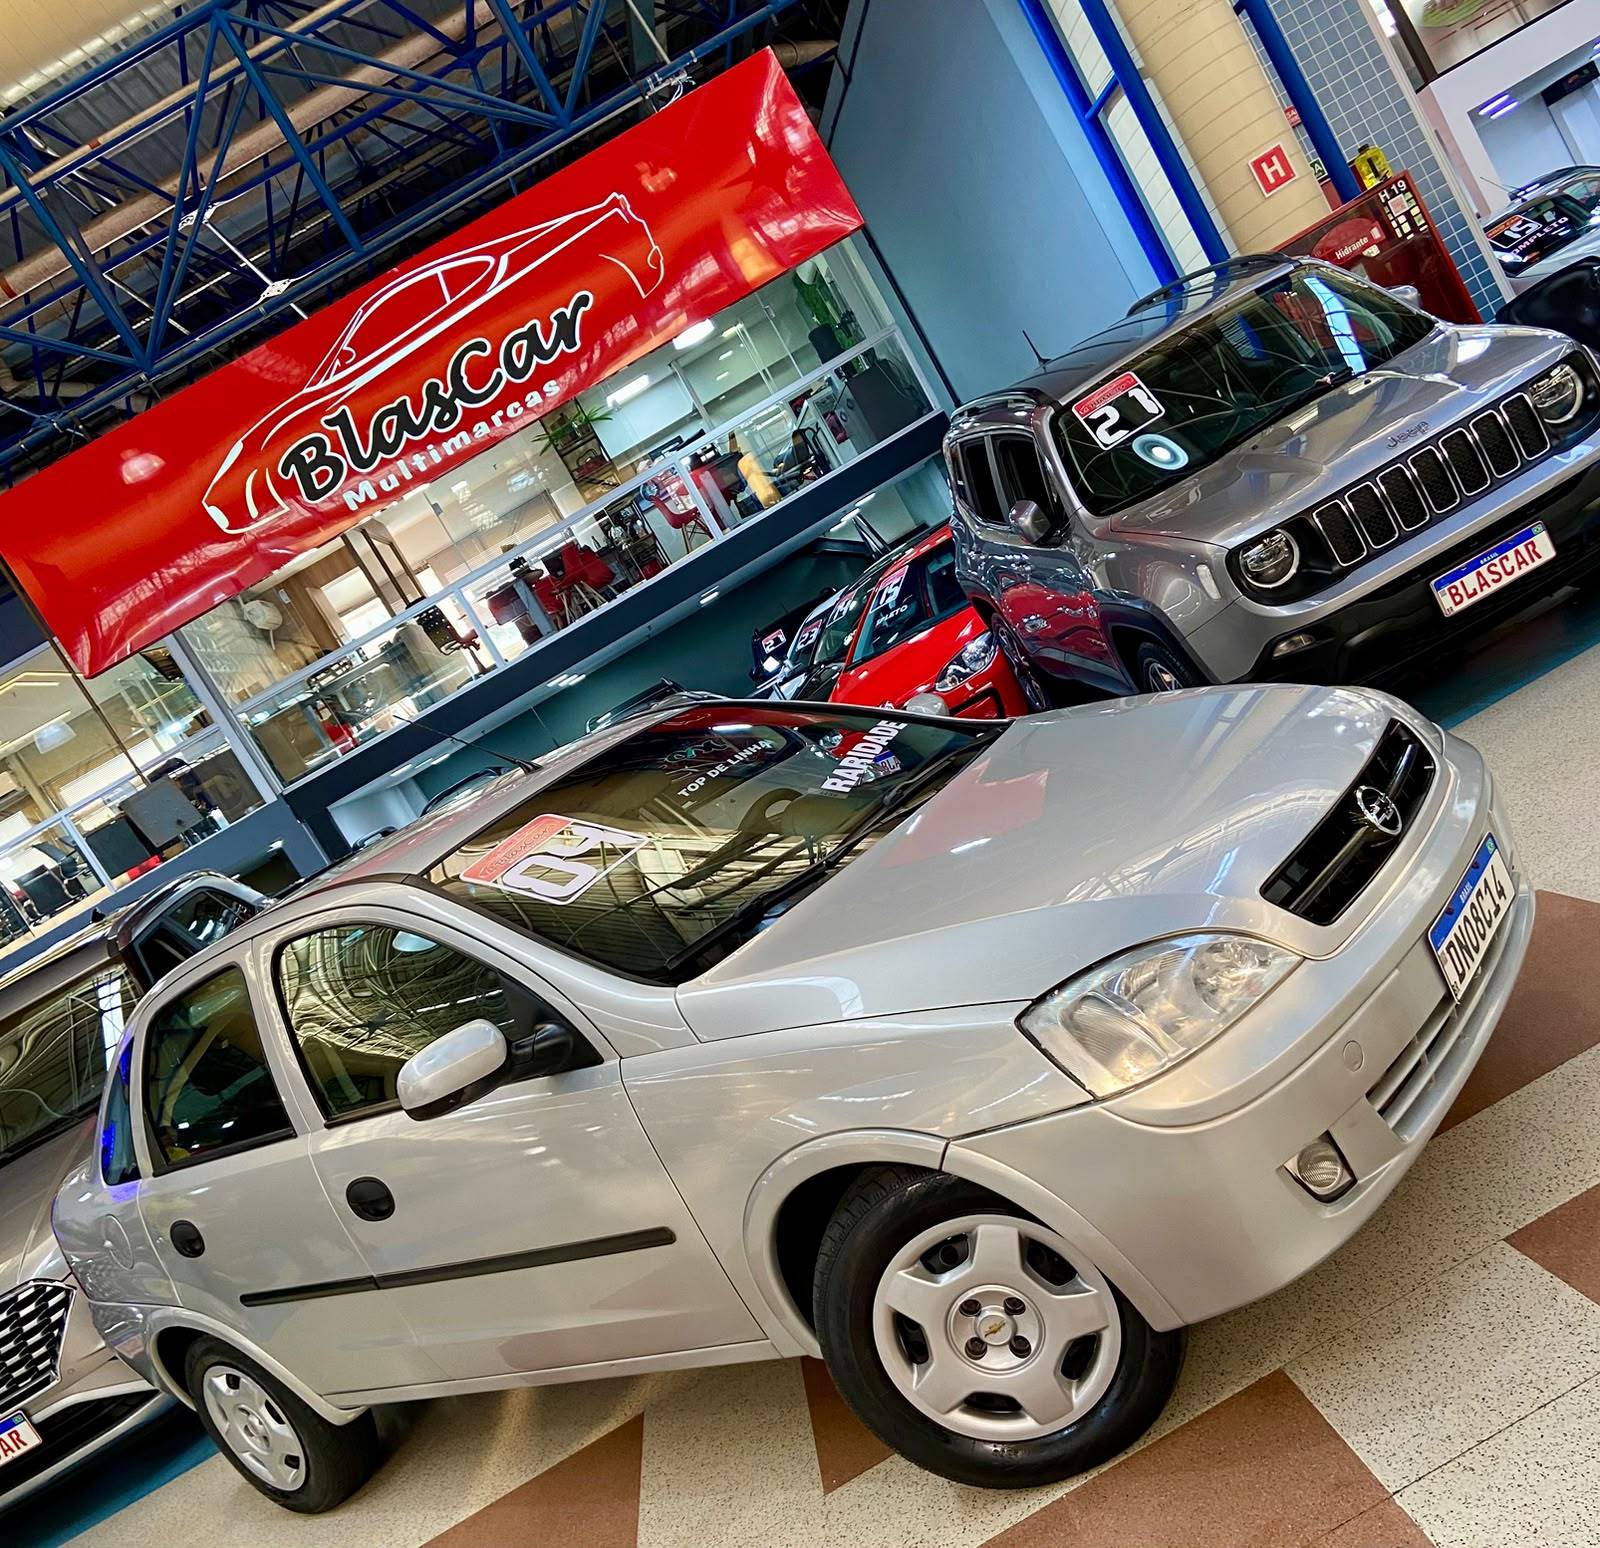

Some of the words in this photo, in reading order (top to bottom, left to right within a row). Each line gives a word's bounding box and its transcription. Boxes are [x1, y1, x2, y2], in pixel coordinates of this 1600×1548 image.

[1261, 155, 1286, 185] H
[1379, 188, 1391, 203] H
[1391, 180, 1407, 195] 19
[1504, 219, 1538, 239] 15
[1511, 216, 1569, 256] OMPLETO
[1335, 236, 1369, 260] Hidrante
[279, 292, 592, 502] BlasCar
[1088, 387, 1160, 445] 21
[343, 379, 561, 512] Multimarcas
[1386, 420, 1430, 449] Jeep
[1447, 540, 1543, 607] BLASCAR
[1479, 551, 1499, 565] BRASIL
[677, 776, 706, 798] TOP
[708, 762, 728, 779] DE
[727, 739, 774, 765] LINHA
[821, 720, 908, 793] RARIDADE
[0, 1429, 28, 1460] AR
